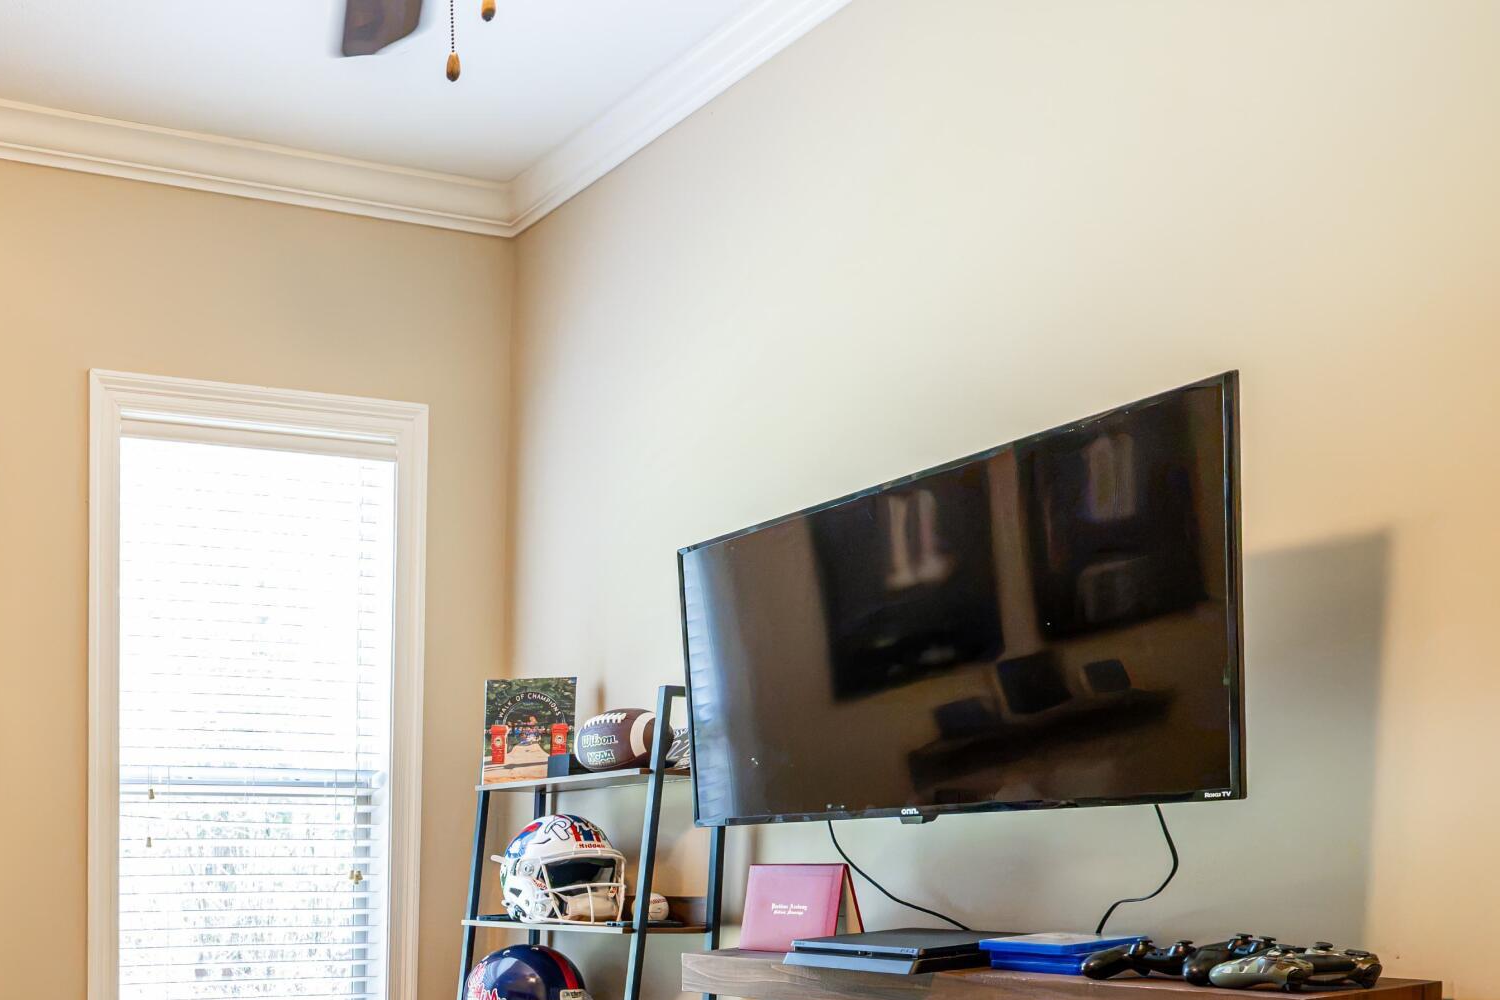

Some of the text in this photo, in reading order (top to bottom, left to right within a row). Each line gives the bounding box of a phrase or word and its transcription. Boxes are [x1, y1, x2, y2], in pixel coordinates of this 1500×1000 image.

[499, 692, 561, 718] WALK OF CHAMPIONS
[582, 734, 616, 748] Wilson
